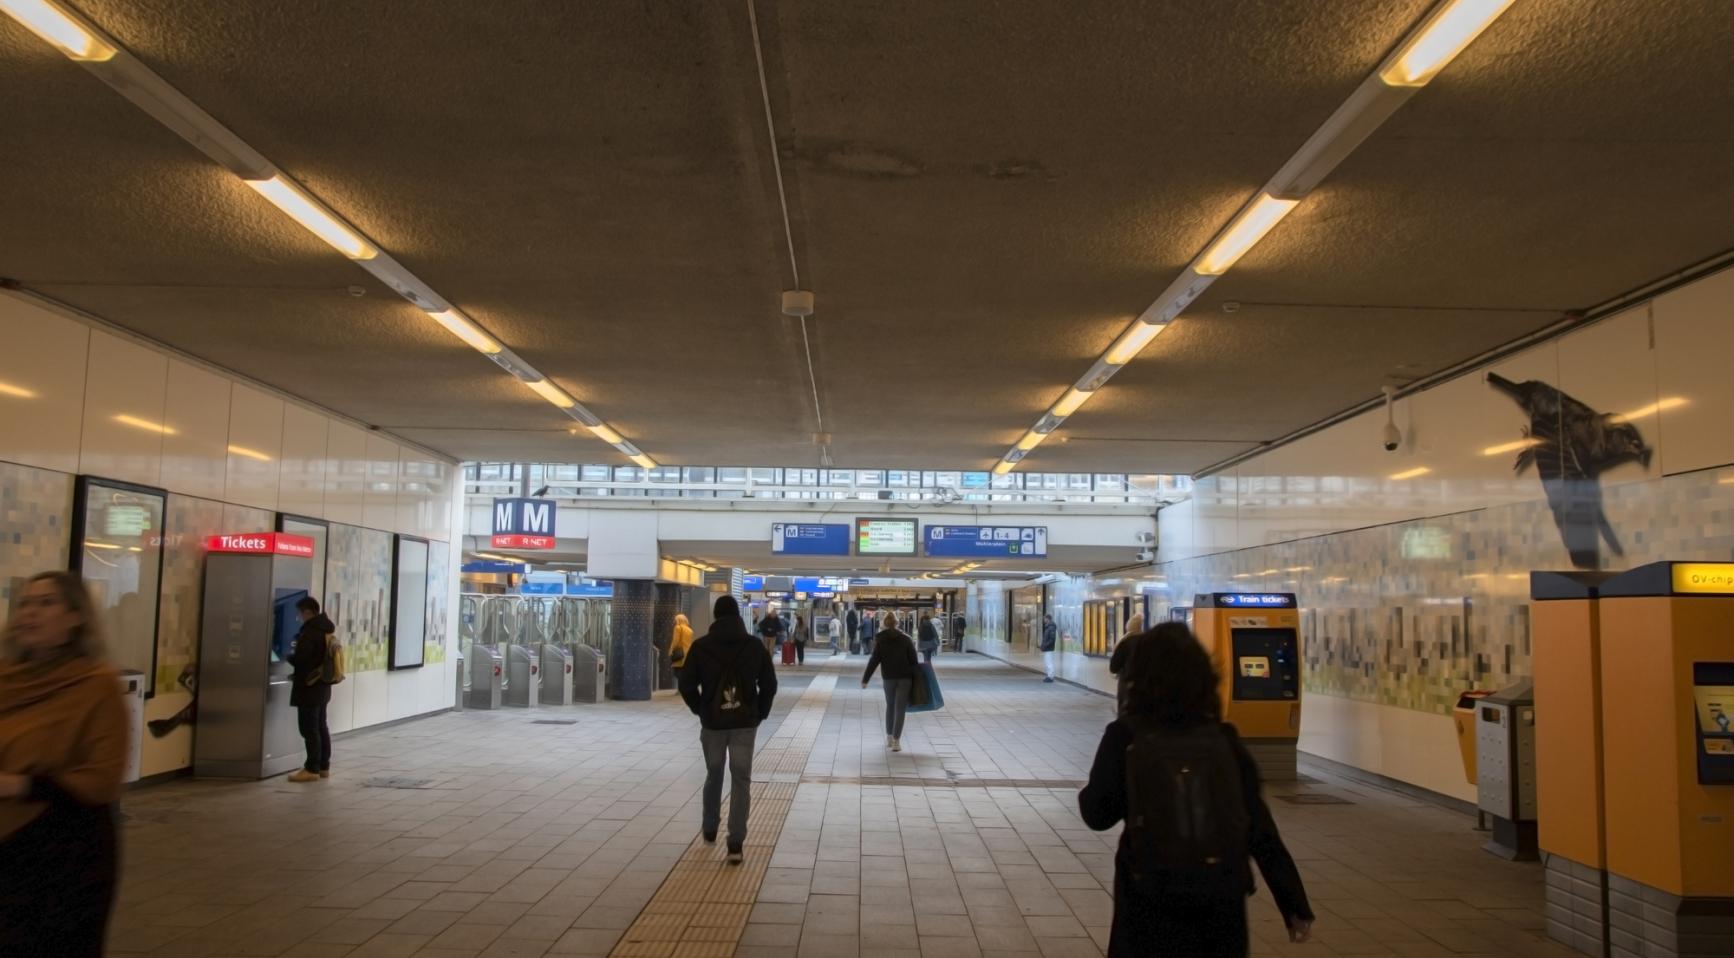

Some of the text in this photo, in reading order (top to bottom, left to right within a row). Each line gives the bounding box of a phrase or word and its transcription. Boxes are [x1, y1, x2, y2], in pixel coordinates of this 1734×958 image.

[496, 502, 512, 532] M
[523, 502, 549, 533] M
[787, 528, 796, 537] M
[221, 536, 266, 549] Tickets
[1238, 595, 1290, 604] Train tickets
